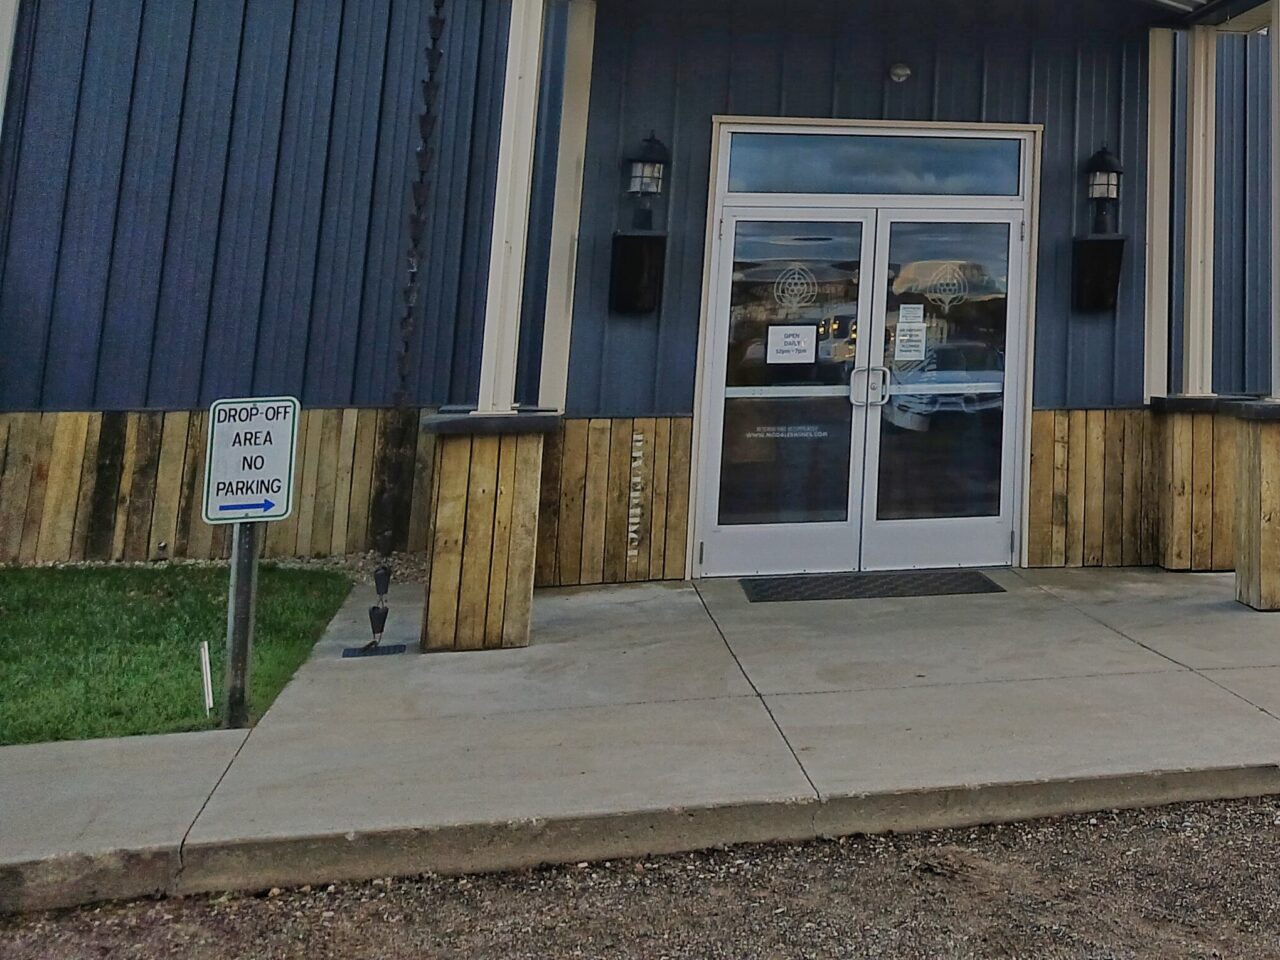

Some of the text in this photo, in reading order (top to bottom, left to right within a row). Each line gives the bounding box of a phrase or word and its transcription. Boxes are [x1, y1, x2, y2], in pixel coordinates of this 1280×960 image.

[217, 406, 292, 424] DROP-OFF
[232, 430, 273, 447] AREA
[242, 455, 265, 471] NO
[216, 478, 282, 497] PARKING
